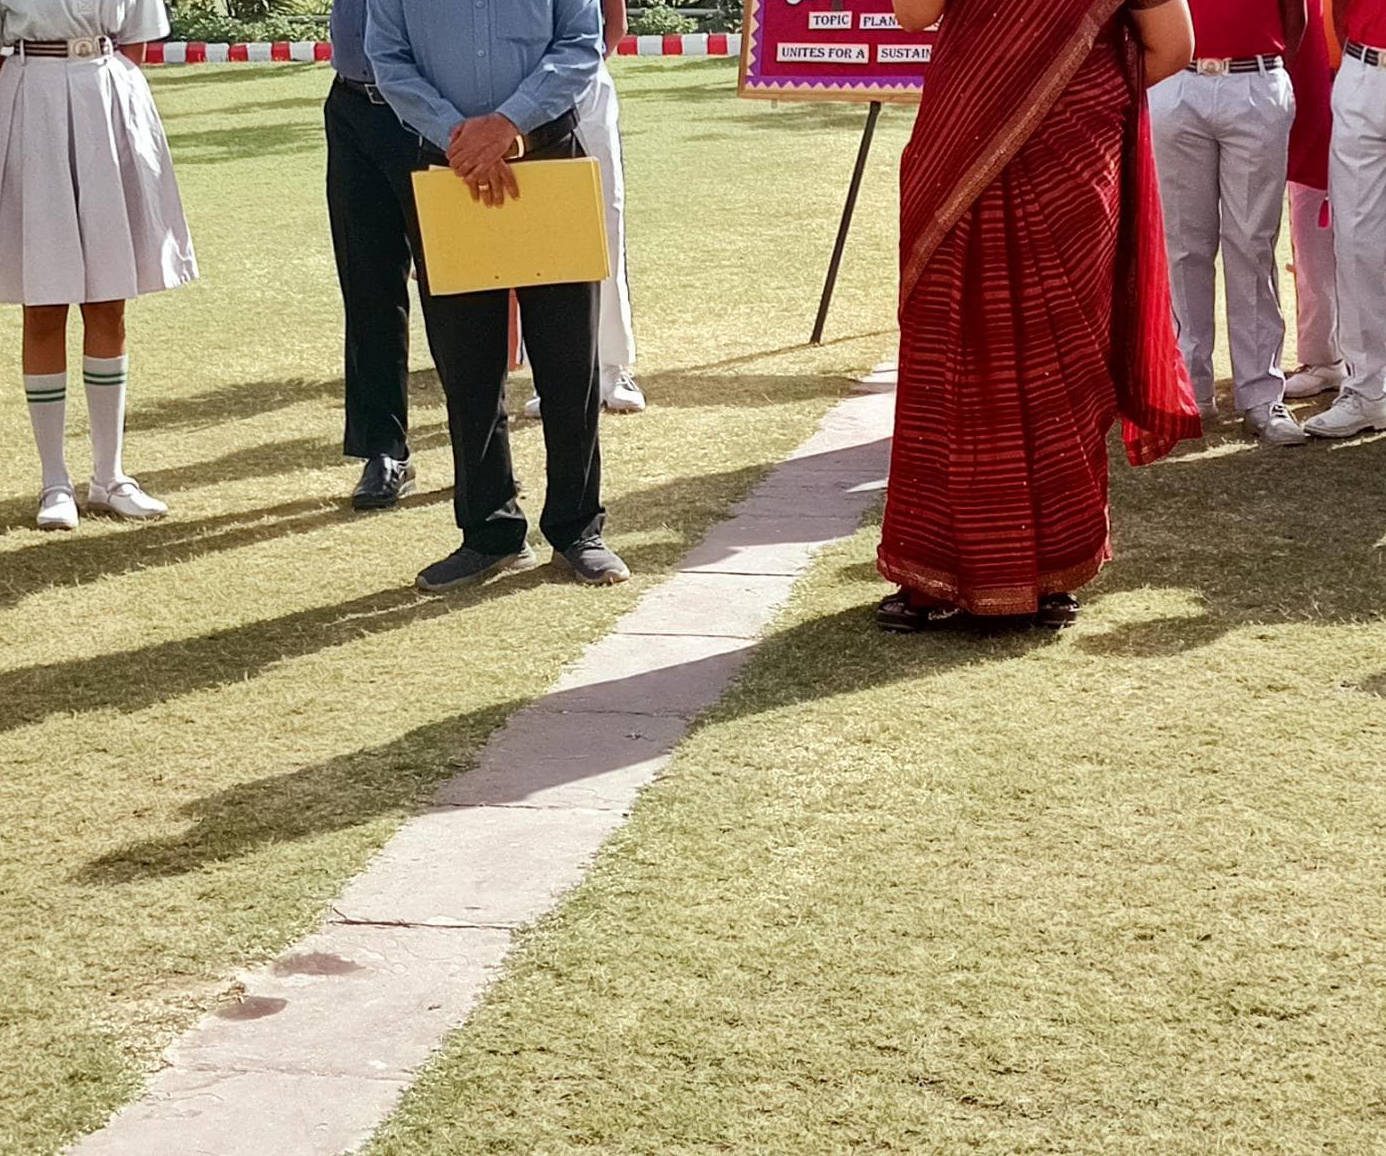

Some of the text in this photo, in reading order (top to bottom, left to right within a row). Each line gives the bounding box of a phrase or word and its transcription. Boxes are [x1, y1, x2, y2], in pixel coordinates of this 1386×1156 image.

[813, 14, 899, 27] TOPIC PLAN
[781, 47, 825, 58] UNITES
[828, 48, 852, 59] FOR
[856, 49, 865, 59] A
